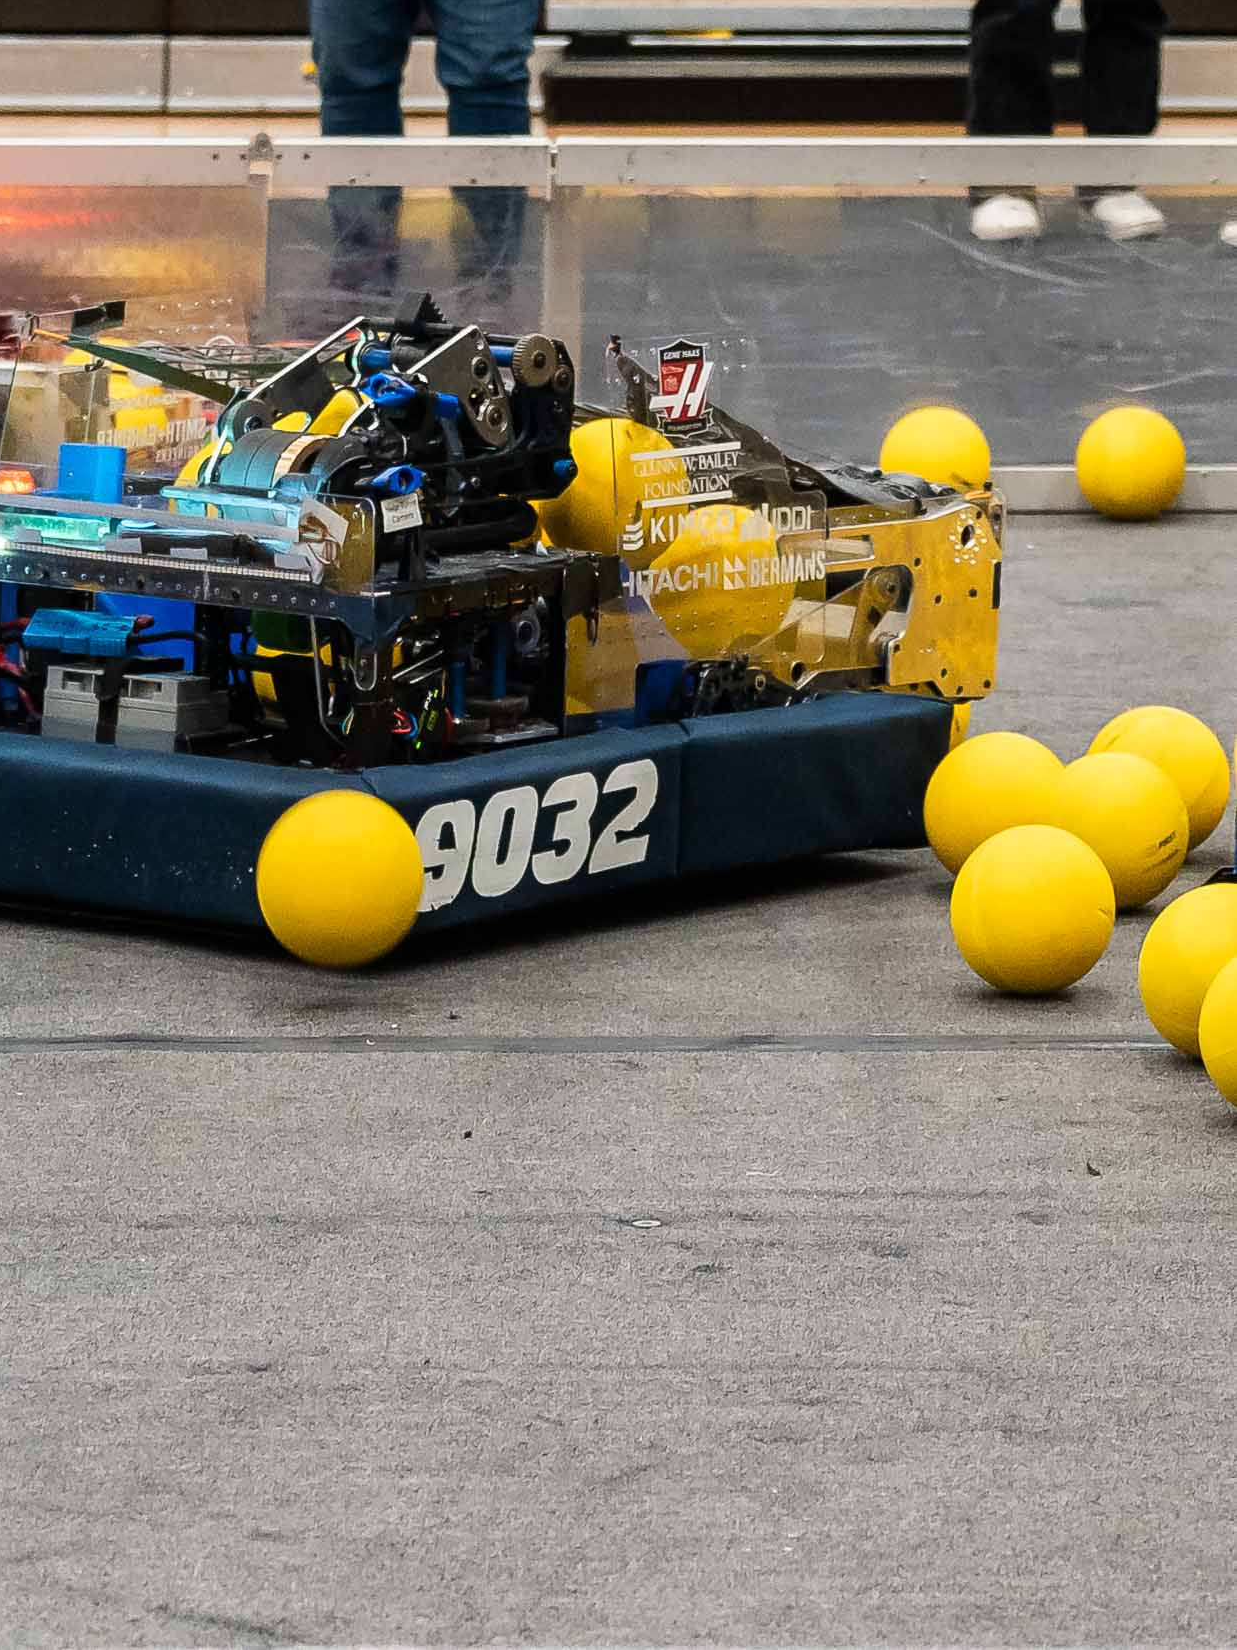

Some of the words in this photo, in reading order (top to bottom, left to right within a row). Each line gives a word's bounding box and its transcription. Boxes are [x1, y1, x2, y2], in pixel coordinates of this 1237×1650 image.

[633, 458, 679, 478] GLENN
[698, 450, 740, 471] BAILEY
[643, 473, 731, 499] FOUNDATION
[622, 561, 719, 598] HITACHI
[415, 758, 659, 913] 9032
